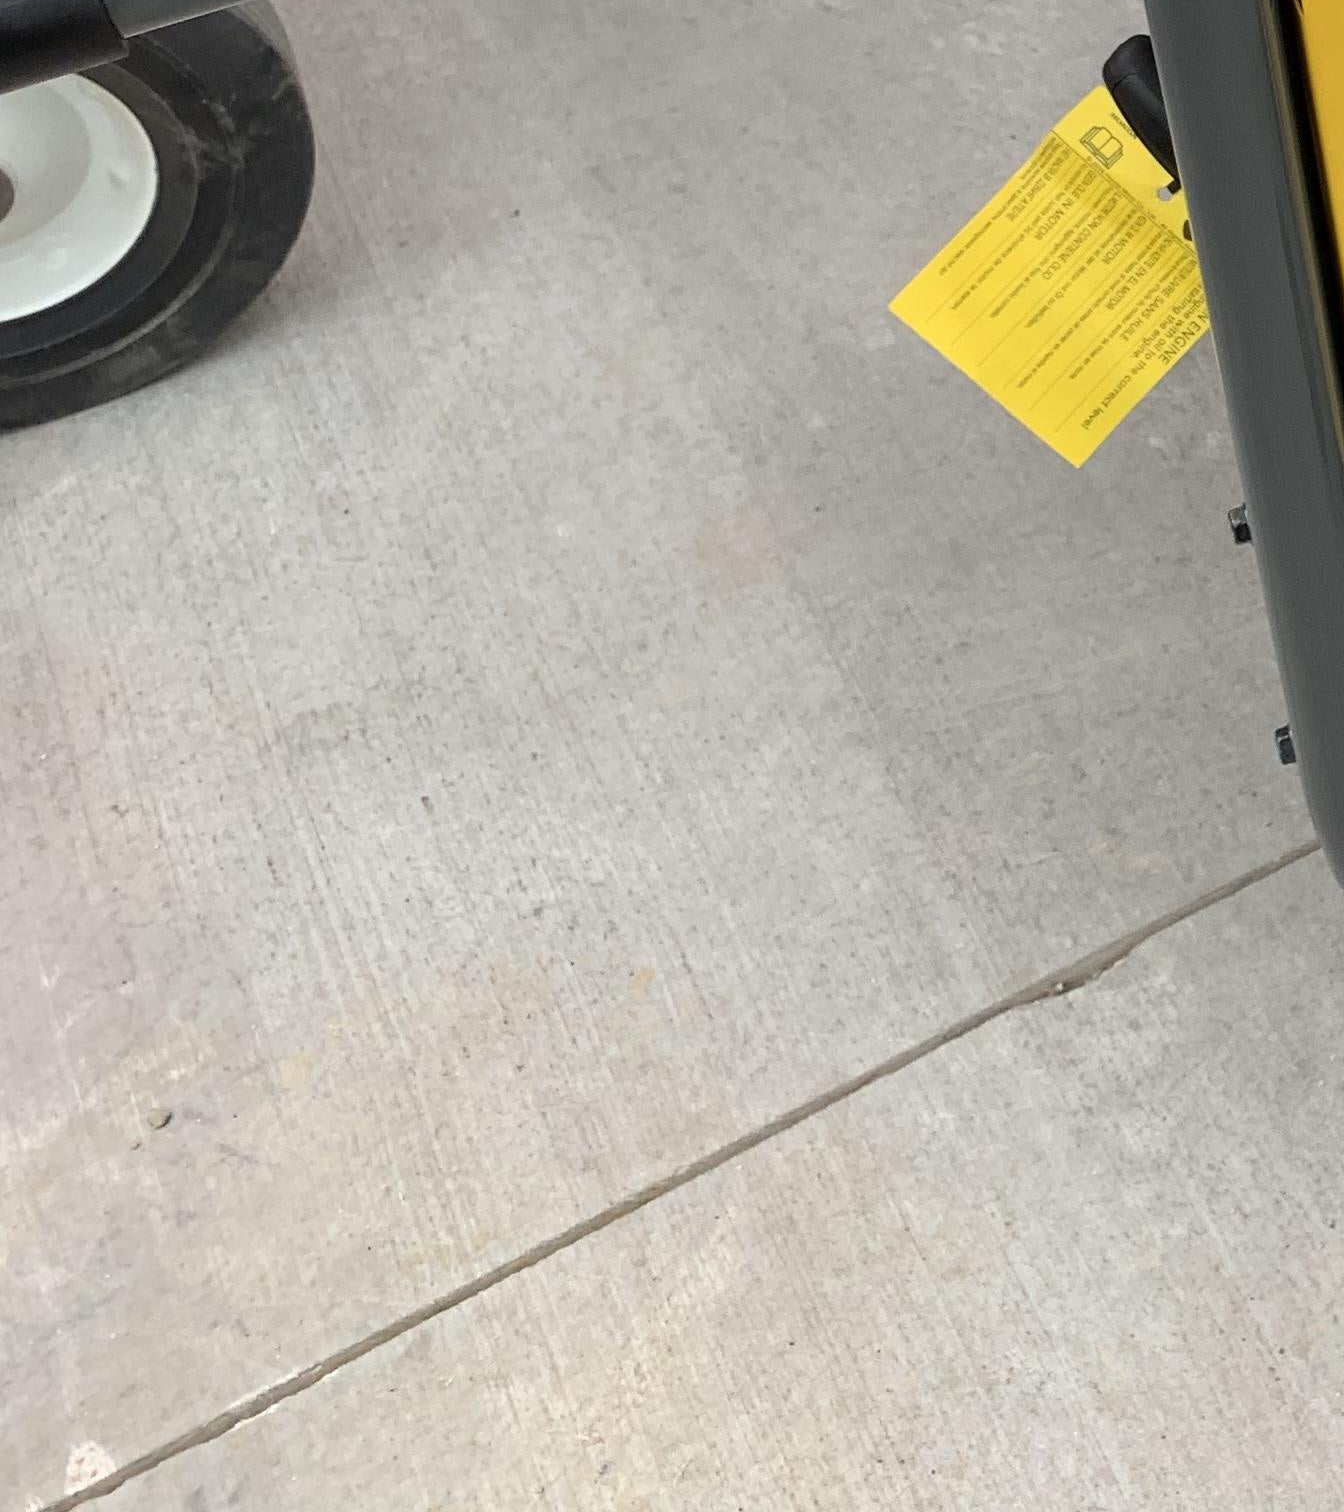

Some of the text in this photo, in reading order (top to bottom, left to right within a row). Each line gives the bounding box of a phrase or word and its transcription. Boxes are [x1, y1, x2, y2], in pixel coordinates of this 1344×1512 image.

[1164, 318, 1185, 340] with
[1157, 320, 1201, 365] ENGINE
[1130, 359, 1147, 376] the
[1100, 374, 1132, 408] correct
[1080, 406, 1104, 430] level
